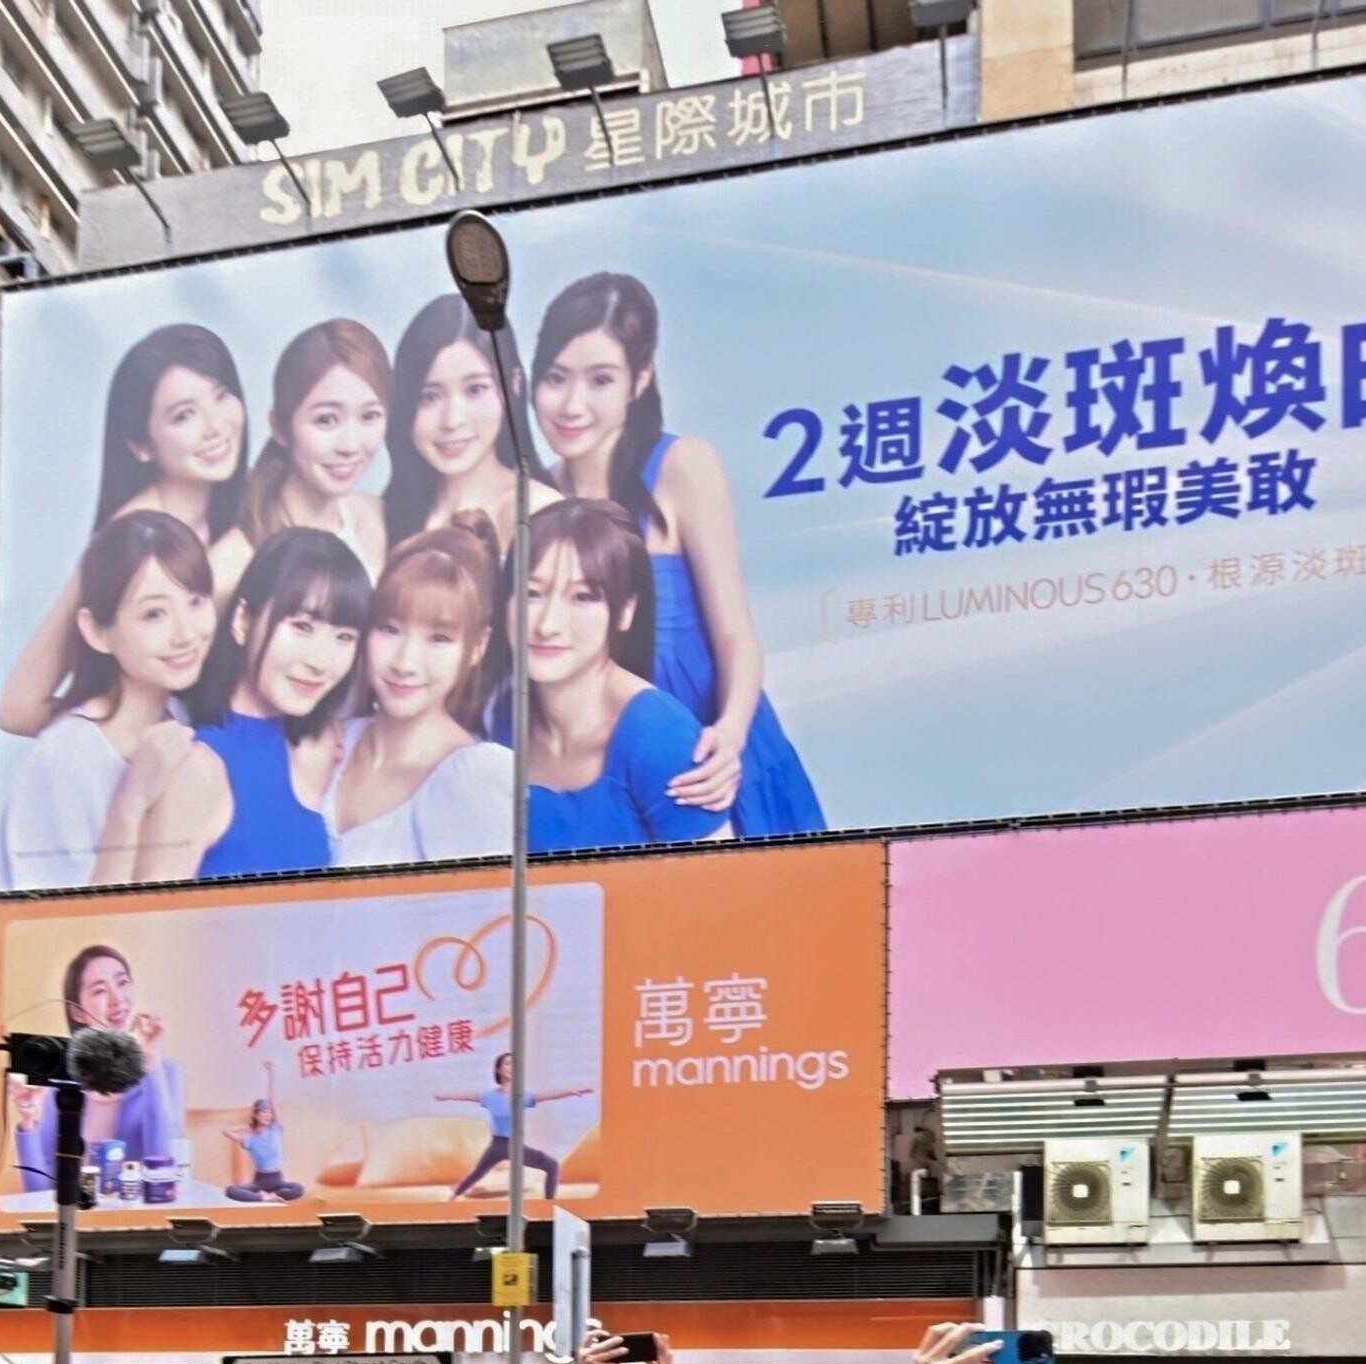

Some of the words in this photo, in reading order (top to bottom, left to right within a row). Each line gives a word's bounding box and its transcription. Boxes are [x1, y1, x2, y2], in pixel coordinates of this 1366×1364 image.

[585, 70, 868, 173] 星際城市
[260, 153, 384, 226] SIM
[400, 112, 566, 204] CITY
[893, 447, 1317, 558] 綻放無瑕美敢
[237, 963, 415, 1047] 多謝自己
[634, 973, 769, 1047] 萬寧
[296, 1019, 474, 1079] 保持活力健康
[632, 1044, 849, 1091] mannings
[284, 1318, 351, 1355] 萬寧
